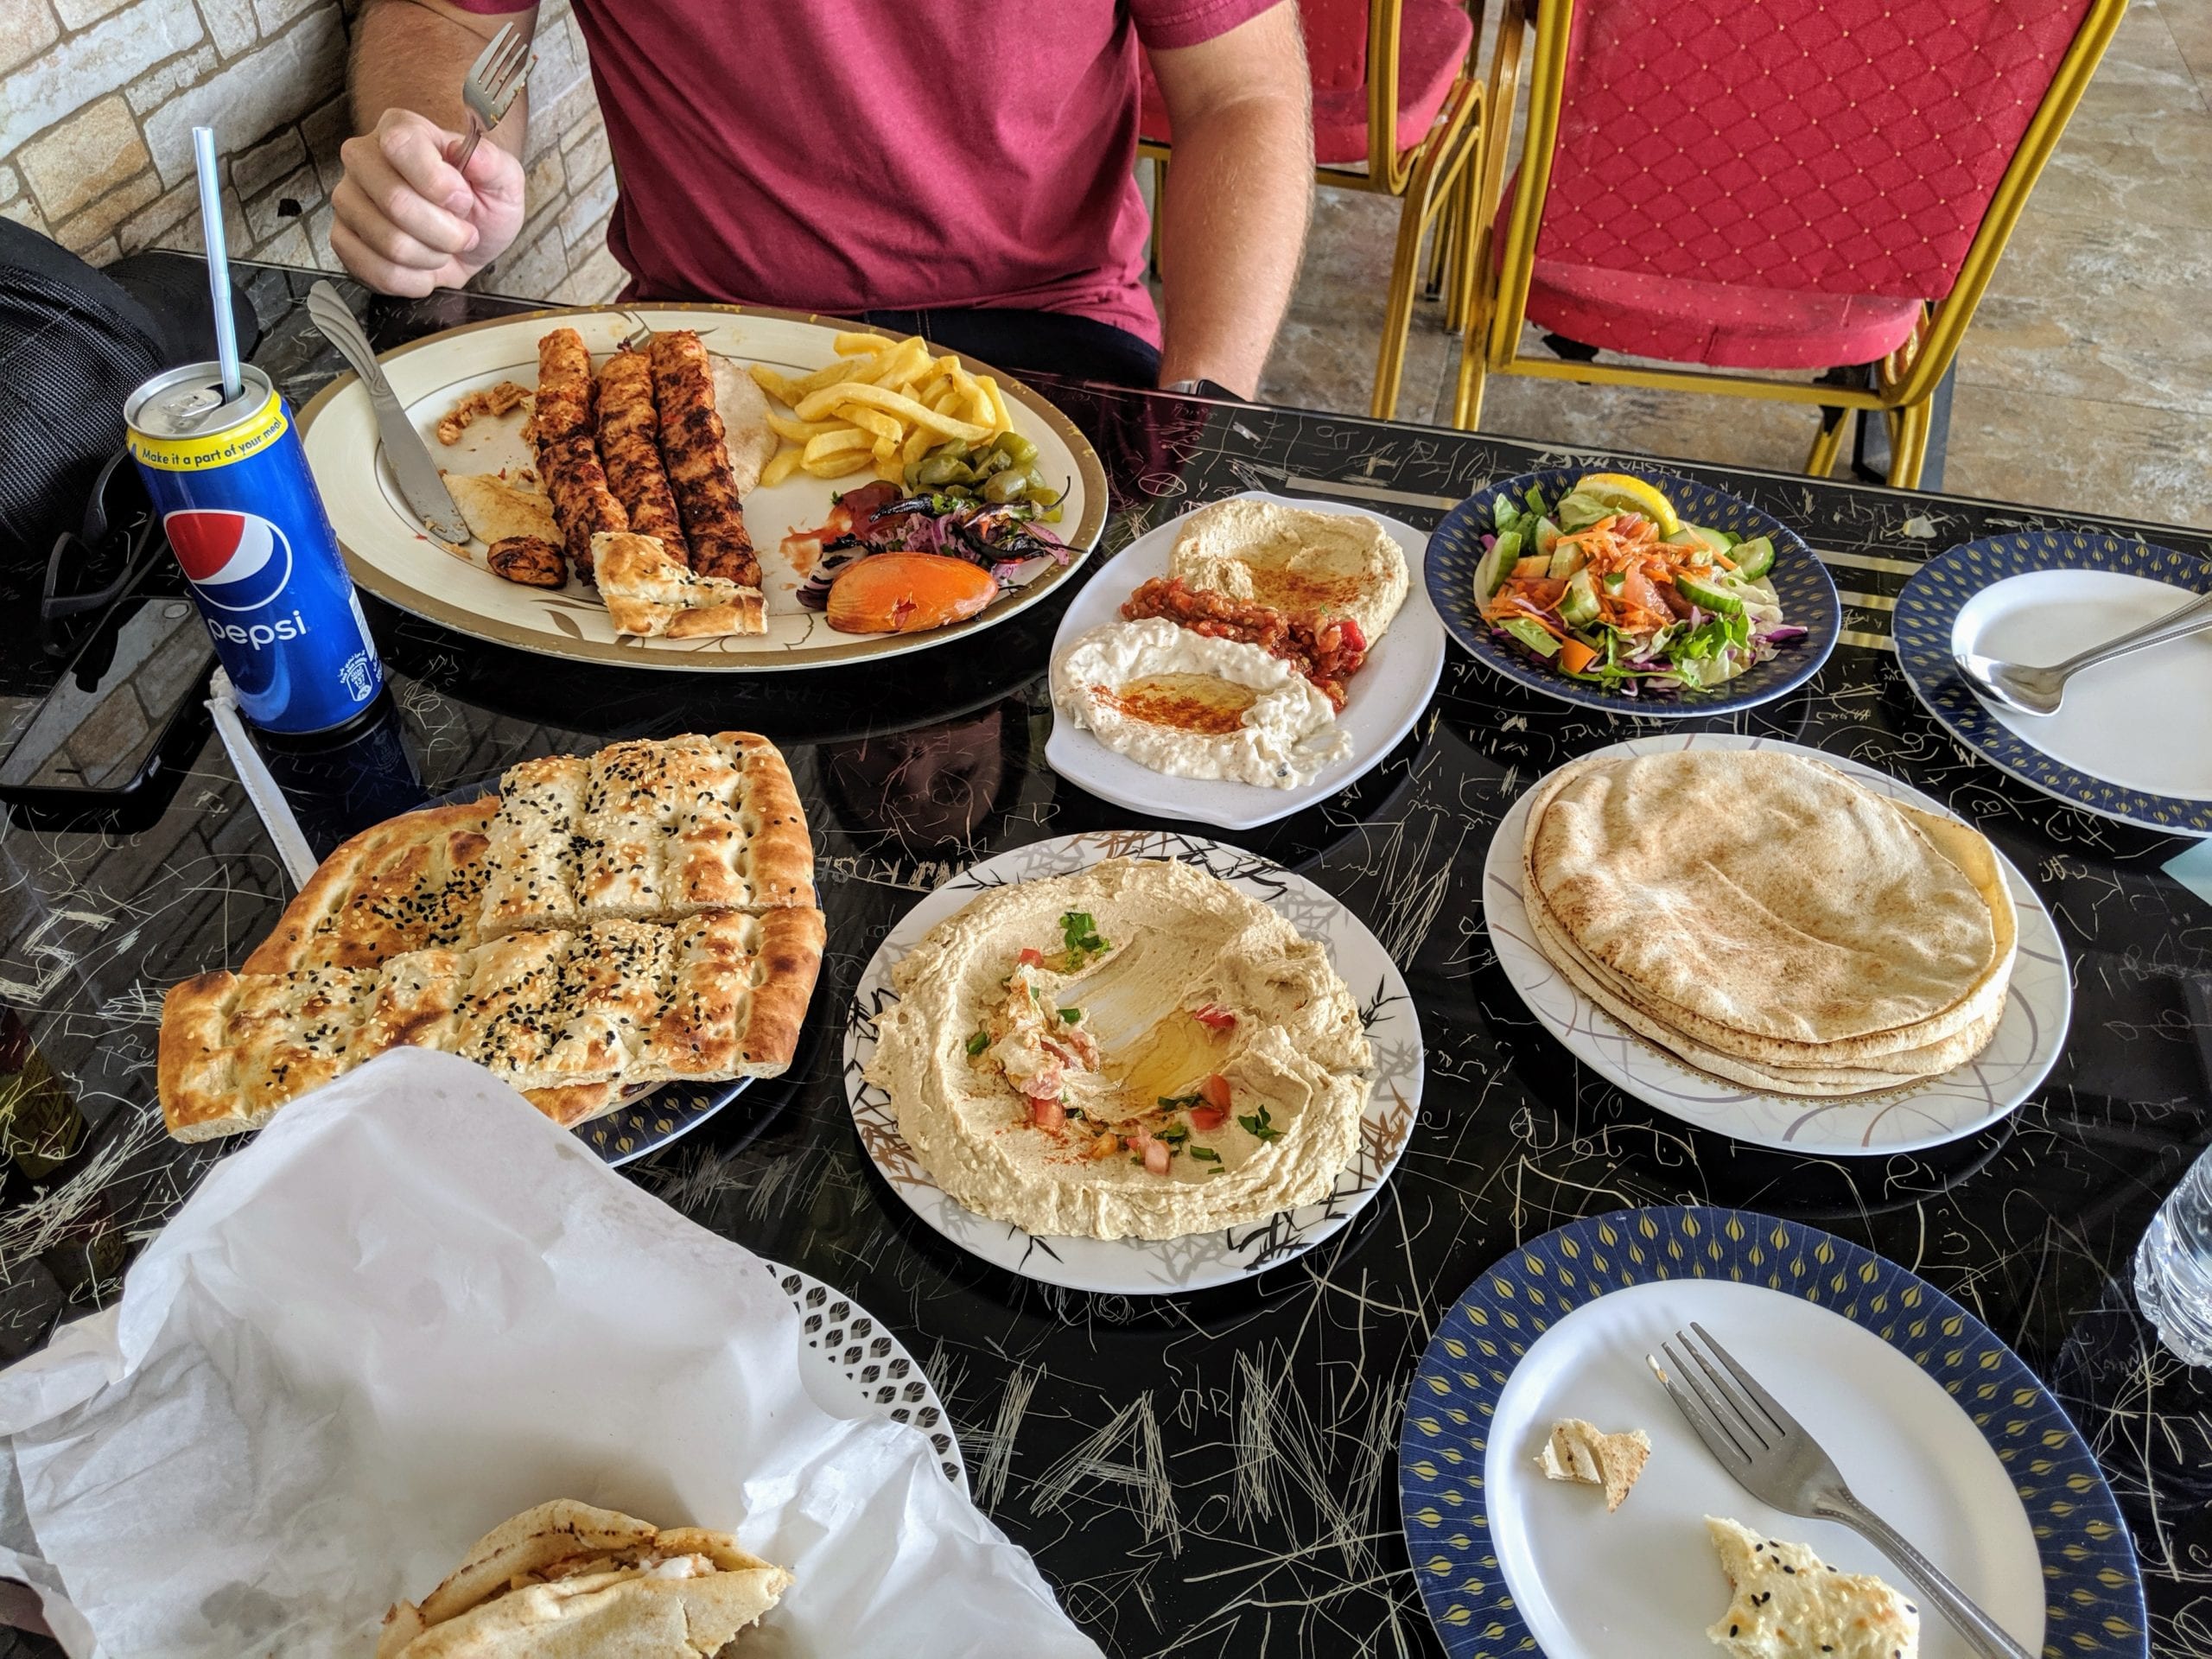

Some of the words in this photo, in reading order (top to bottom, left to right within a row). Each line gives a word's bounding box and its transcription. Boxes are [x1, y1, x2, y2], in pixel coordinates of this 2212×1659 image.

[142, 448, 169, 465] Make
[171, 453, 180, 465] it
[183, 455, 191, 465] a
[194, 449, 221, 467] part
[224, 445, 237, 458] of
[239, 435, 262, 455] your
[264, 416, 283, 439] meal
[207, 609, 307, 651] pepsi
